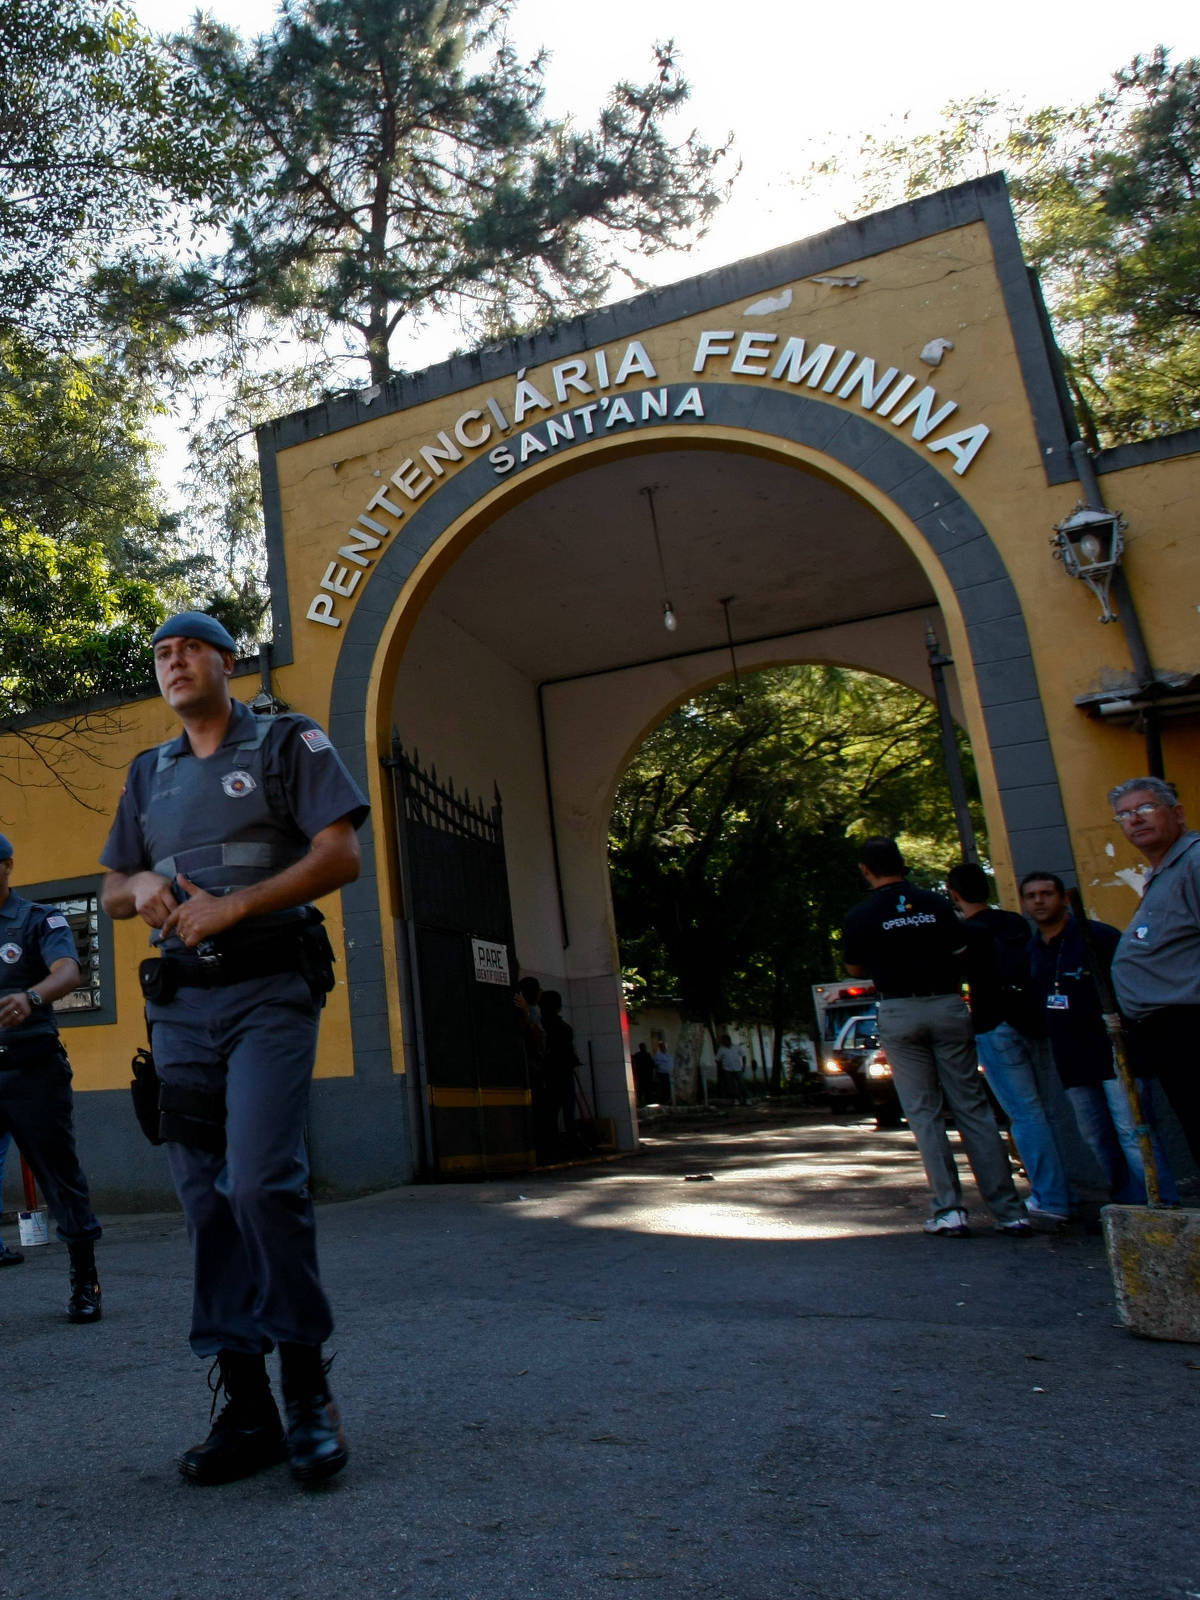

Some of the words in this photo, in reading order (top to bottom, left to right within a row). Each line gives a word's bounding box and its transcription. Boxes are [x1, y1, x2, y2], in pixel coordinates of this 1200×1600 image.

[489, 387, 705, 474] SANT'ANA
[306, 341, 658, 627] PENITENCIÁRIA
[693, 330, 991, 476] FEMININA
[882, 912, 937, 930] OPERAÇÕES
[478, 946, 504, 969] PARE
